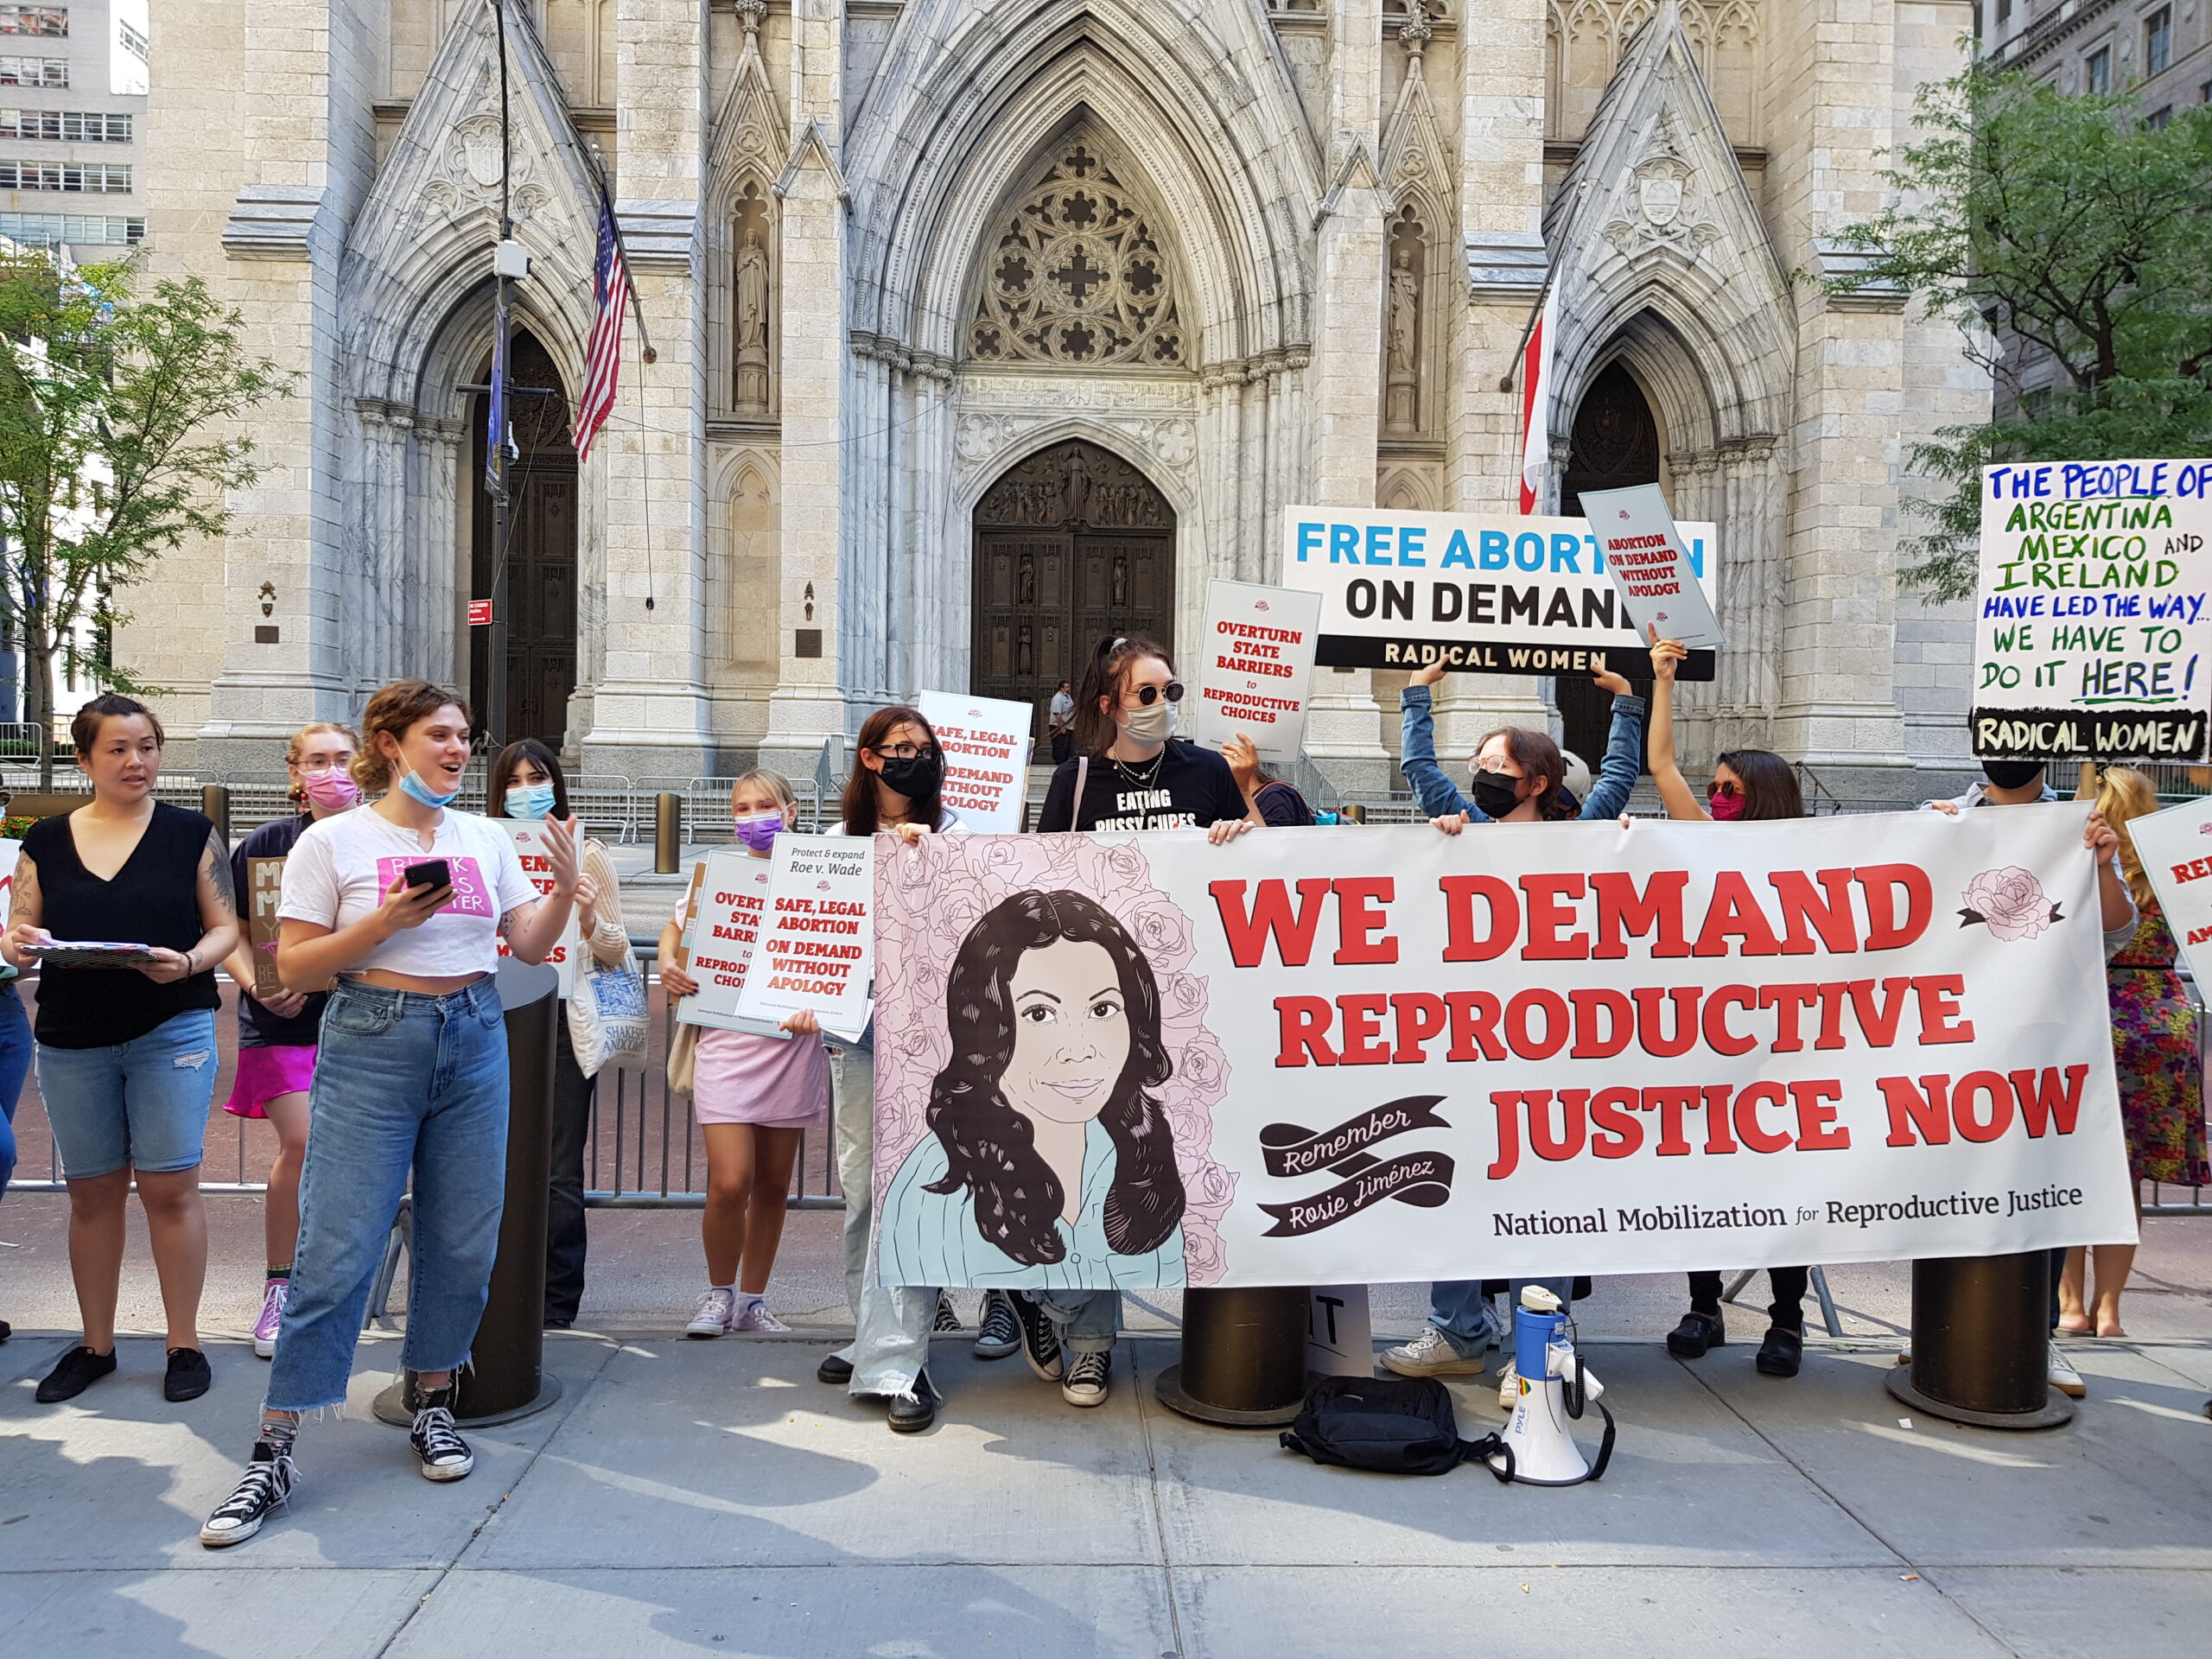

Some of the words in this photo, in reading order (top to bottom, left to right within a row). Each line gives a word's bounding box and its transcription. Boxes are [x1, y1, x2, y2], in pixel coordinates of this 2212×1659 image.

[1989, 467, 2052, 499] THE
[2061, 462, 2169, 499] PEOPLE
[2177, 464, 2212, 499] OF
[2005, 501, 2173, 532] ARGENTINA
[1296, 522, 1427, 568] FREE
[1440, 529, 1704, 579] ABORTN
[1607, 533, 1667, 550] ABORTION
[2018, 533, 2146, 562] MEXICO
[2164, 533, 2203, 556] AND
[1608, 554, 1624, 566] ON
[1624, 550, 1678, 566] DEMAND
[1619, 566, 1676, 582] WITHOUT
[1993, 560, 2179, 591] IRELAND
[1345, 578, 1414, 621] ON
[1628, 582, 1681, 597] APOLOGY
[1983, 594, 2045, 619] HAVE
[2052, 595, 2097, 617] LED
[2102, 594, 2141, 618] THE
[1217, 621, 1302, 645] OVERTURN
[1994, 622, 2034, 653] WE
[2051, 625, 2126, 652] HAVE
[2139, 626, 2182, 654] TO
[1233, 641, 1280, 659] STATE
[1385, 644, 1498, 667] RADICAL
[1508, 648, 1606, 671] WOMEN
[1217, 656, 1294, 678] BARRIERS
[1980, 662, 2021, 690] DO
[2036, 660, 2068, 688] IT
[1247, 679, 1257, 690] to
[1204, 687, 1300, 712] REPRODUCTIVE
[1221, 705, 1276, 723] CHOICES
[970, 730, 1018, 746] LEGAL
[1978, 718, 2088, 752] RADICAL
[2095, 720, 2198, 753] WOMEN
[942, 741, 1011, 759] BORTION
[946, 766, 1014, 784] DEMAND
[941, 780, 1003, 798] ITHOUT
[940, 794, 1000, 812] POLOGY
[1116, 789, 1172, 811] EATING
[791, 848, 823, 858] Protect
[832, 850, 865, 860] expand
[790, 861, 812, 874] Roe
[816, 865, 823, 874] v.
[829, 863, 862, 875] Wade
[715, 892, 765, 911] OVERT
[775, 897, 817, 916] SAFE,
[818, 901, 867, 917] LEGAL
[731, 911, 761, 927] STA
[777, 917, 859, 935] ABORTION
[1207, 875, 1399, 969] WE
[1439, 862, 1935, 965] DEMAND
[742, 950, 753, 958] to
[766, 939, 791, 954] ON
[793, 941, 863, 960] DEMAND
[696, 956, 749, 974] REPROD
[772, 957, 851, 977] WITHOUT
[767, 976, 847, 996] APOLOGY
[1272, 974, 1976, 1069] REPRODUCTIVE
[1487, 1078, 1852, 1181] JUSTICE
[1875, 1063, 2089, 1147] NOW
[1282, 1110, 1411, 1174] Remember
[1289, 1194, 1349, 1230] Rosie
[1353, 1160, 1435, 1207] Jiménez
[1493, 1207, 1607, 1237] National
[1618, 1202, 1788, 1233] Mobilization
[1796, 1206, 1820, 1228] for
[1826, 1192, 2000, 1229] Reproductive
[2006, 1184, 2083, 1218] Justice
[1515, 1405, 1526, 1434] PYLE
